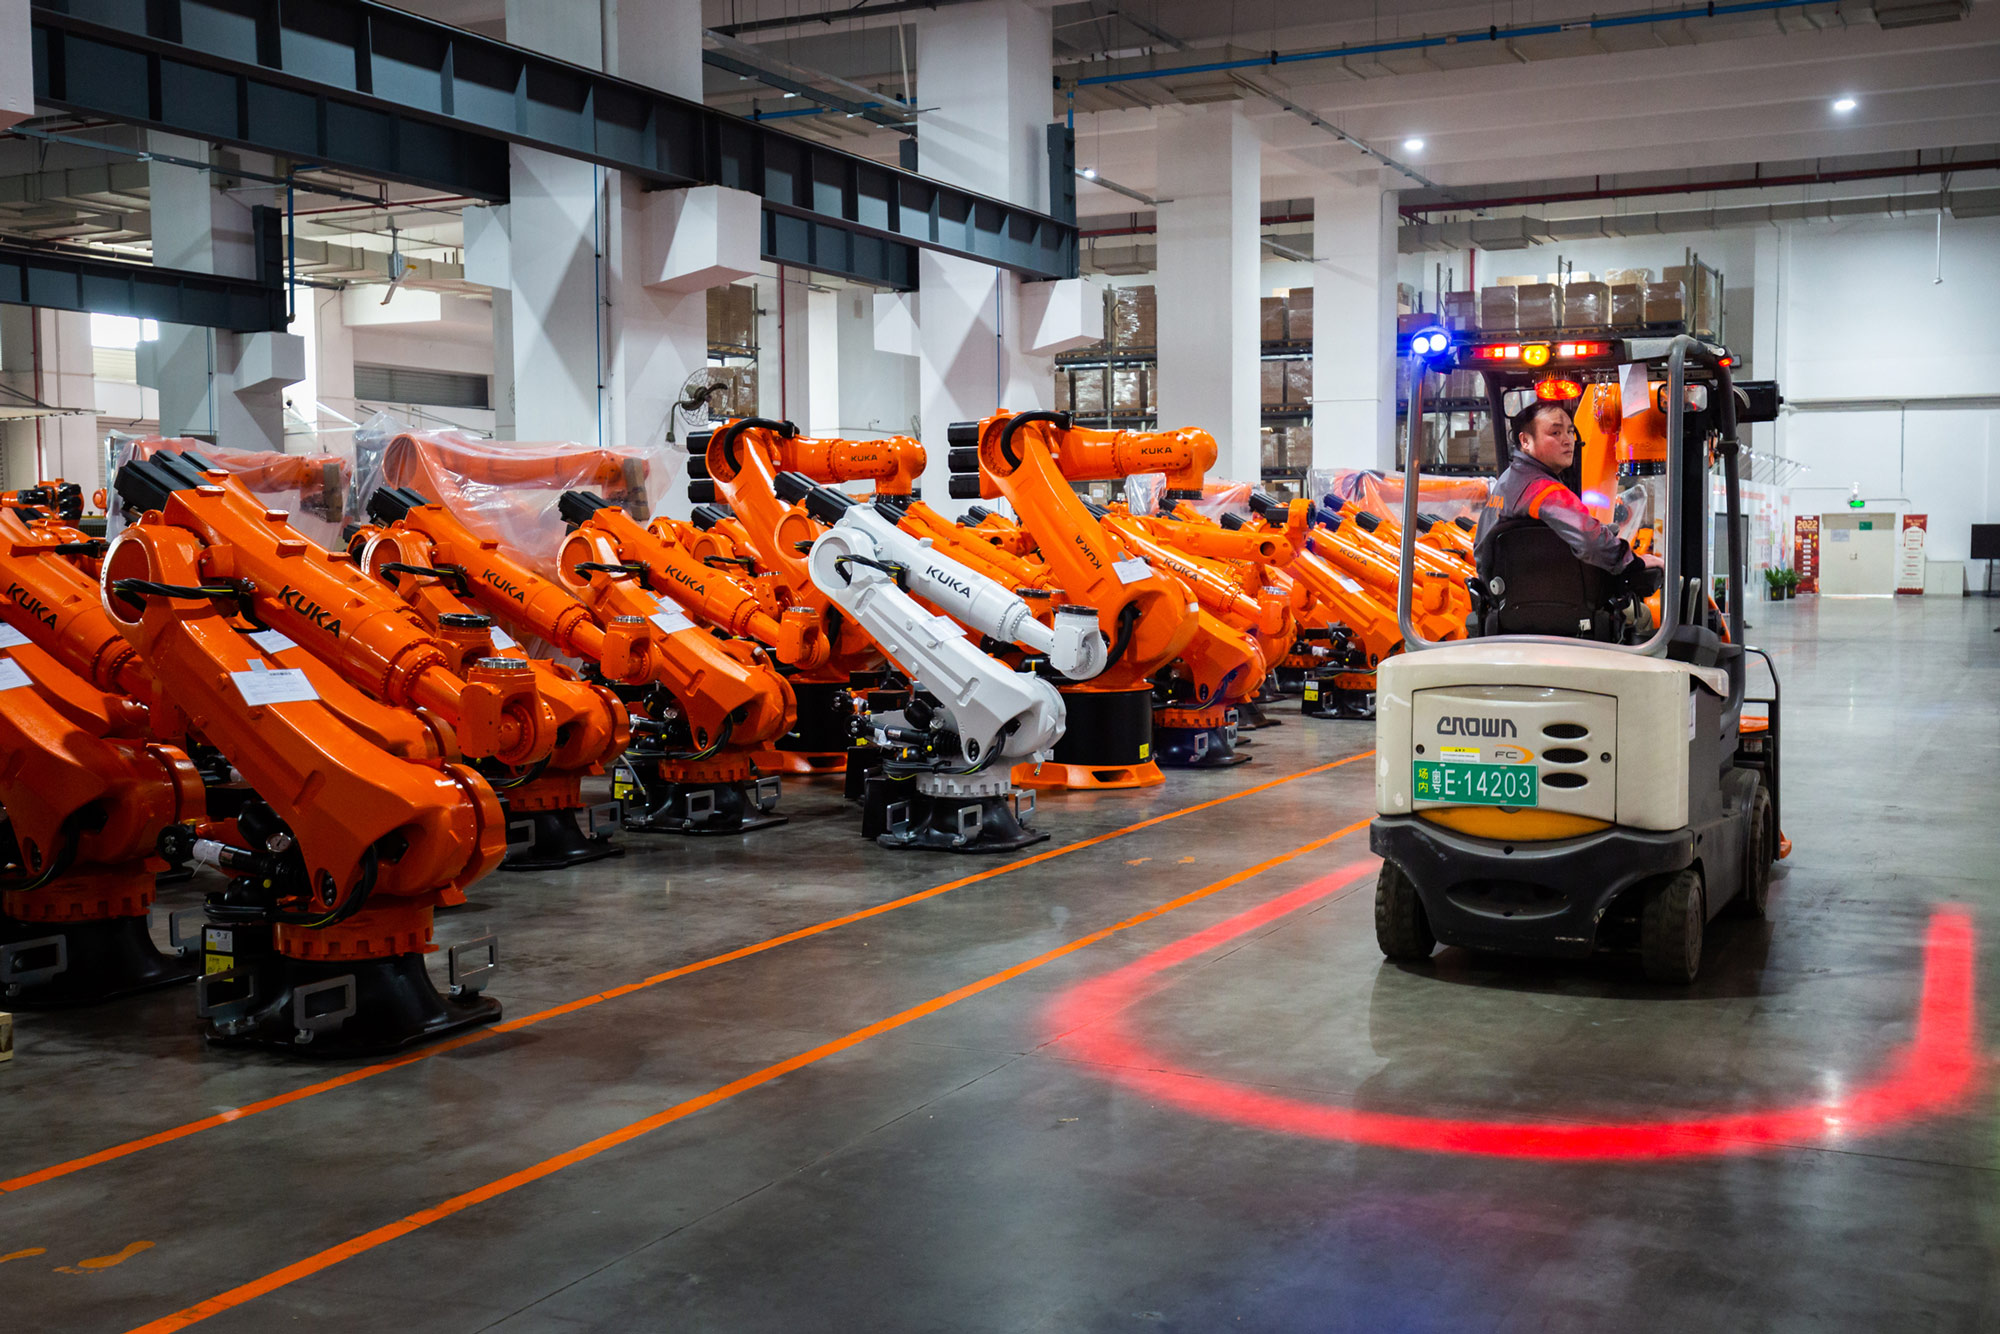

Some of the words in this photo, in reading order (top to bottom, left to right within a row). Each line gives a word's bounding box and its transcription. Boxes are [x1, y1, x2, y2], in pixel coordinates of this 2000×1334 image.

[851, 454, 878, 462] KUKA
[1141, 447, 1173, 455] KUKA
[1796, 519, 1818, 529] 2022
[1075, 535, 1102, 570] KUKA
[1339, 547, 1367, 566] KUKA
[665, 564, 705, 596] KUKA
[926, 565, 971, 598] KUKA
[1163, 558, 1198, 582] KUKA
[483, 568, 524, 604] KUKA
[6, 582, 58, 630] KUKA
[278, 584, 342, 638] KUKA
[1437, 716, 1517, 738] CROWN
[1495, 751, 1517, 759] FC
[1418, 768, 1429, 793] 场内
